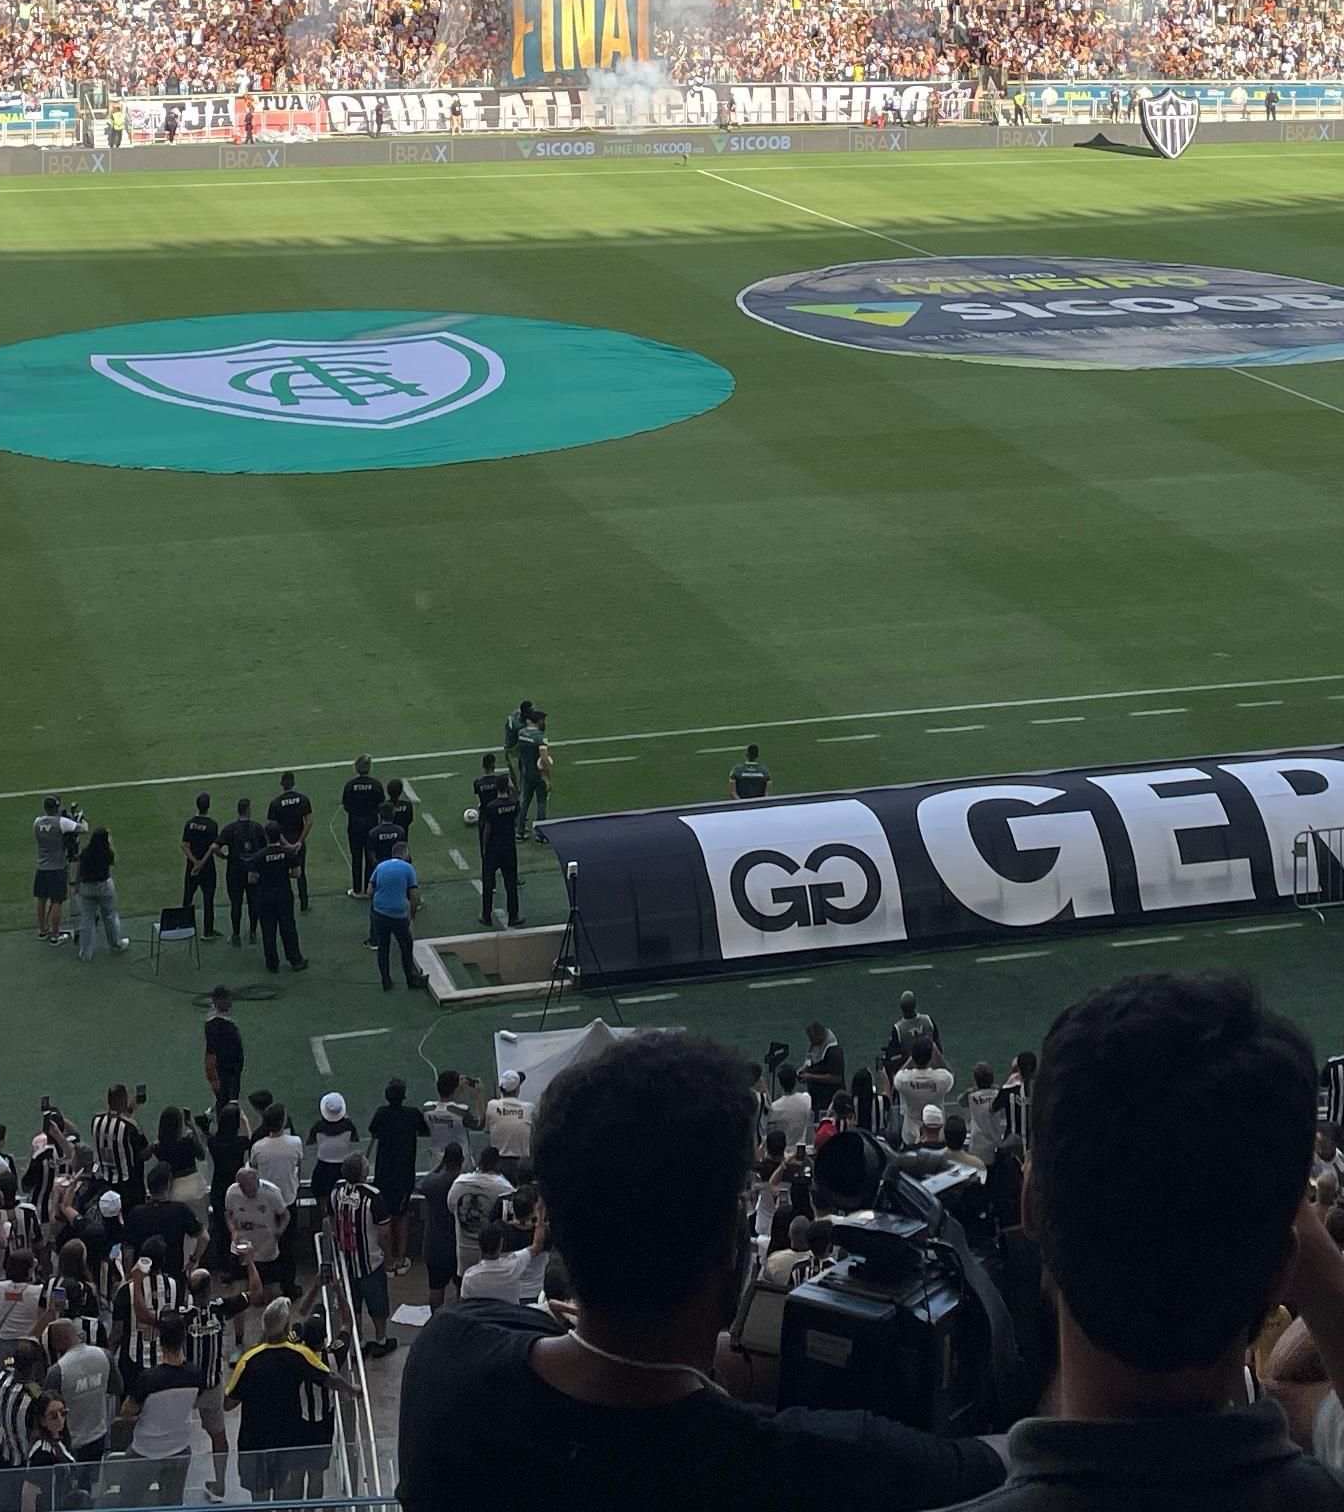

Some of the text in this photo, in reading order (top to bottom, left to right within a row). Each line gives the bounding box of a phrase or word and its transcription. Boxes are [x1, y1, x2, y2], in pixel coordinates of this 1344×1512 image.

[258, 95, 307, 111] TUA
[1002, 129, 1049, 148] BRAX
[1287, 123, 1330, 142] BRAX
[536, 141, 595, 157] SICOOB
[653, 141, 692, 155] SICOOB
[731, 135, 792, 152] SICOOB
[856, 134, 901, 151] BRAX
[226, 148, 280, 169] BRAX
[396, 144, 447, 163] BRAX
[49, 153, 105, 174] BRAX
[885, 274, 1210, 296] MINEIRO
[501, 1106, 525, 1120] bmg
